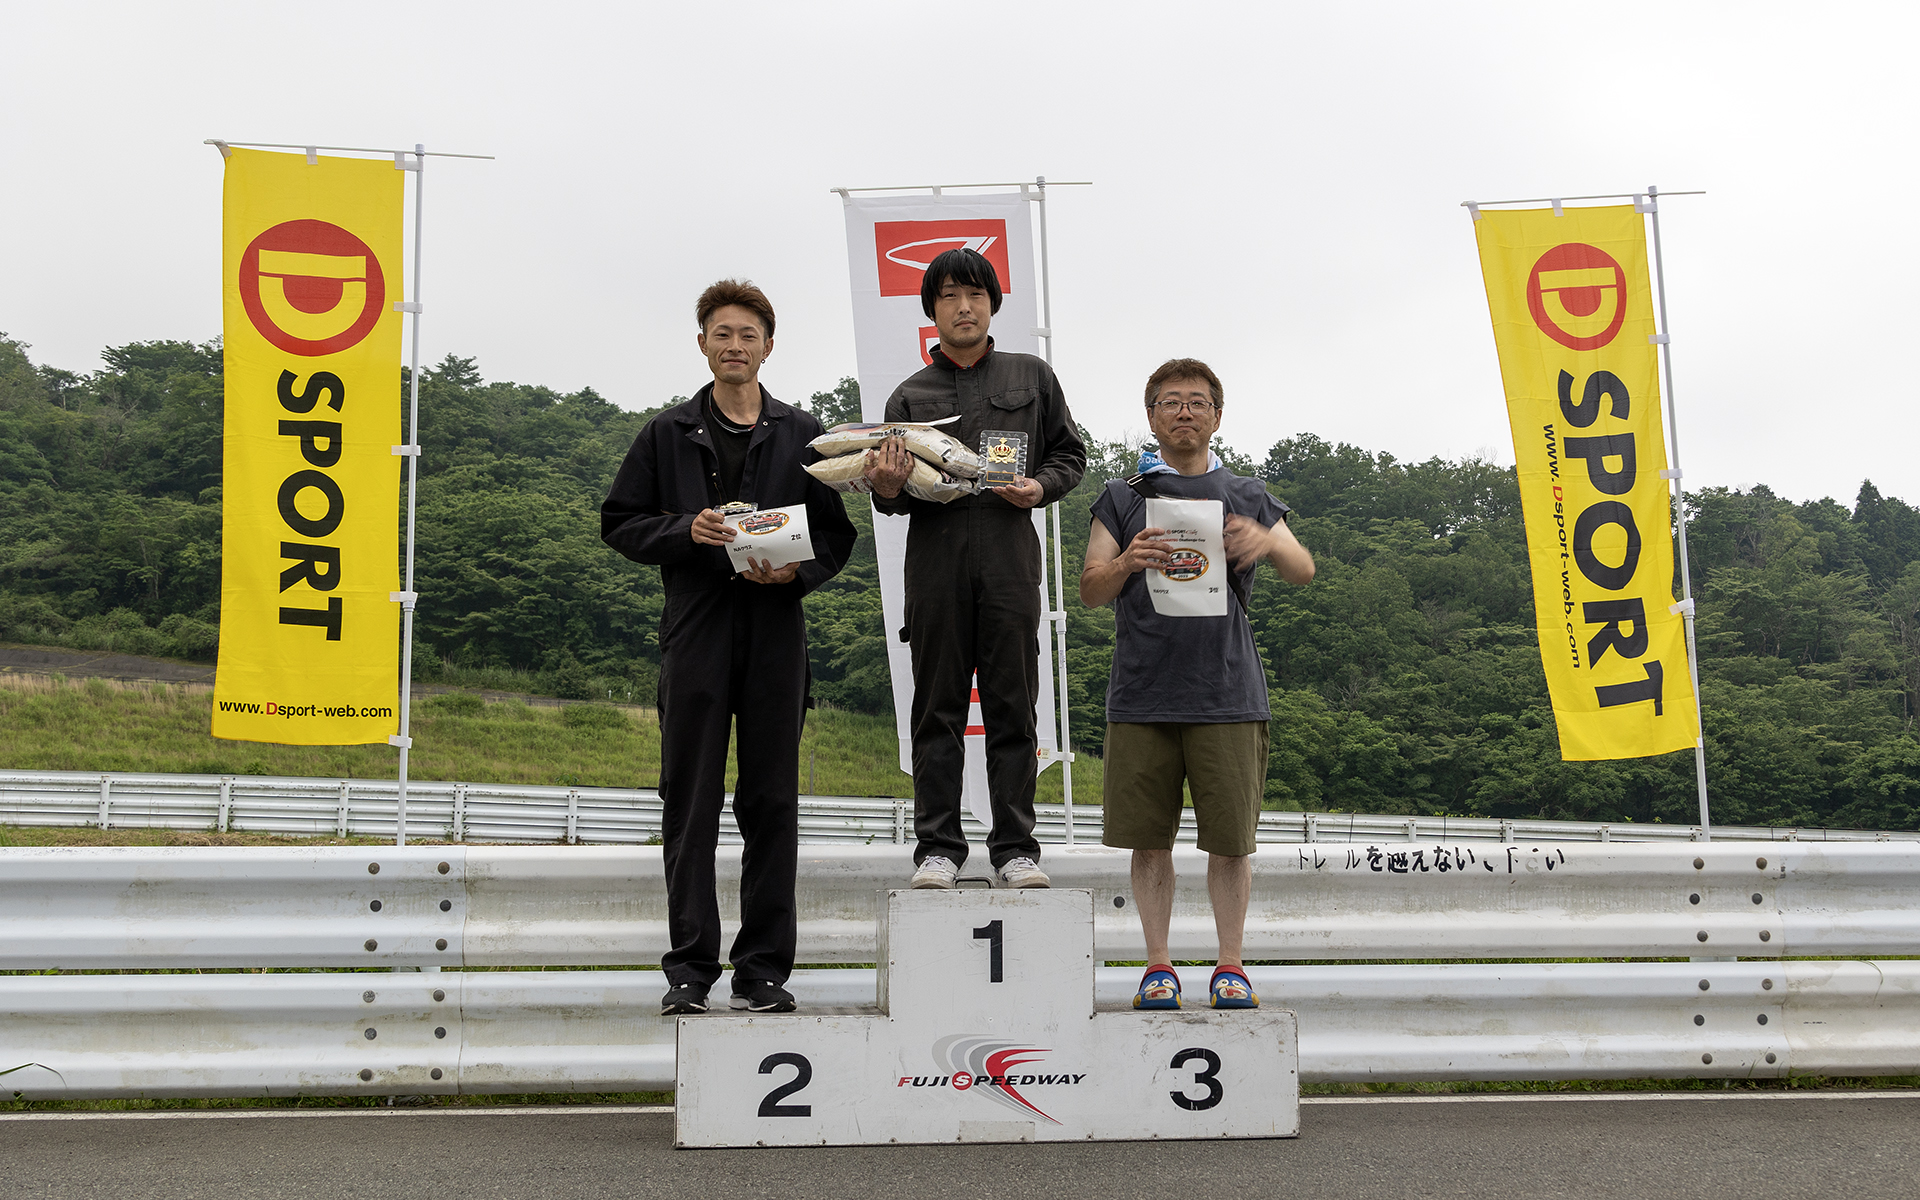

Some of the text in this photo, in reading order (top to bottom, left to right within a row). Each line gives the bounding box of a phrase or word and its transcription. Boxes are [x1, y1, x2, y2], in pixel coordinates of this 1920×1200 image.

[256, 246, 369, 642] D SPORT
[1536, 264, 1664, 717] D SPORT
[1541, 423, 1581, 669] www.Dsport-web.com
[219, 701, 392, 718] www.Dsport-web.com
[973, 919, 1004, 983] 1
[757, 1052, 812, 1117] 2
[1170, 1047, 1224, 1112] 3
